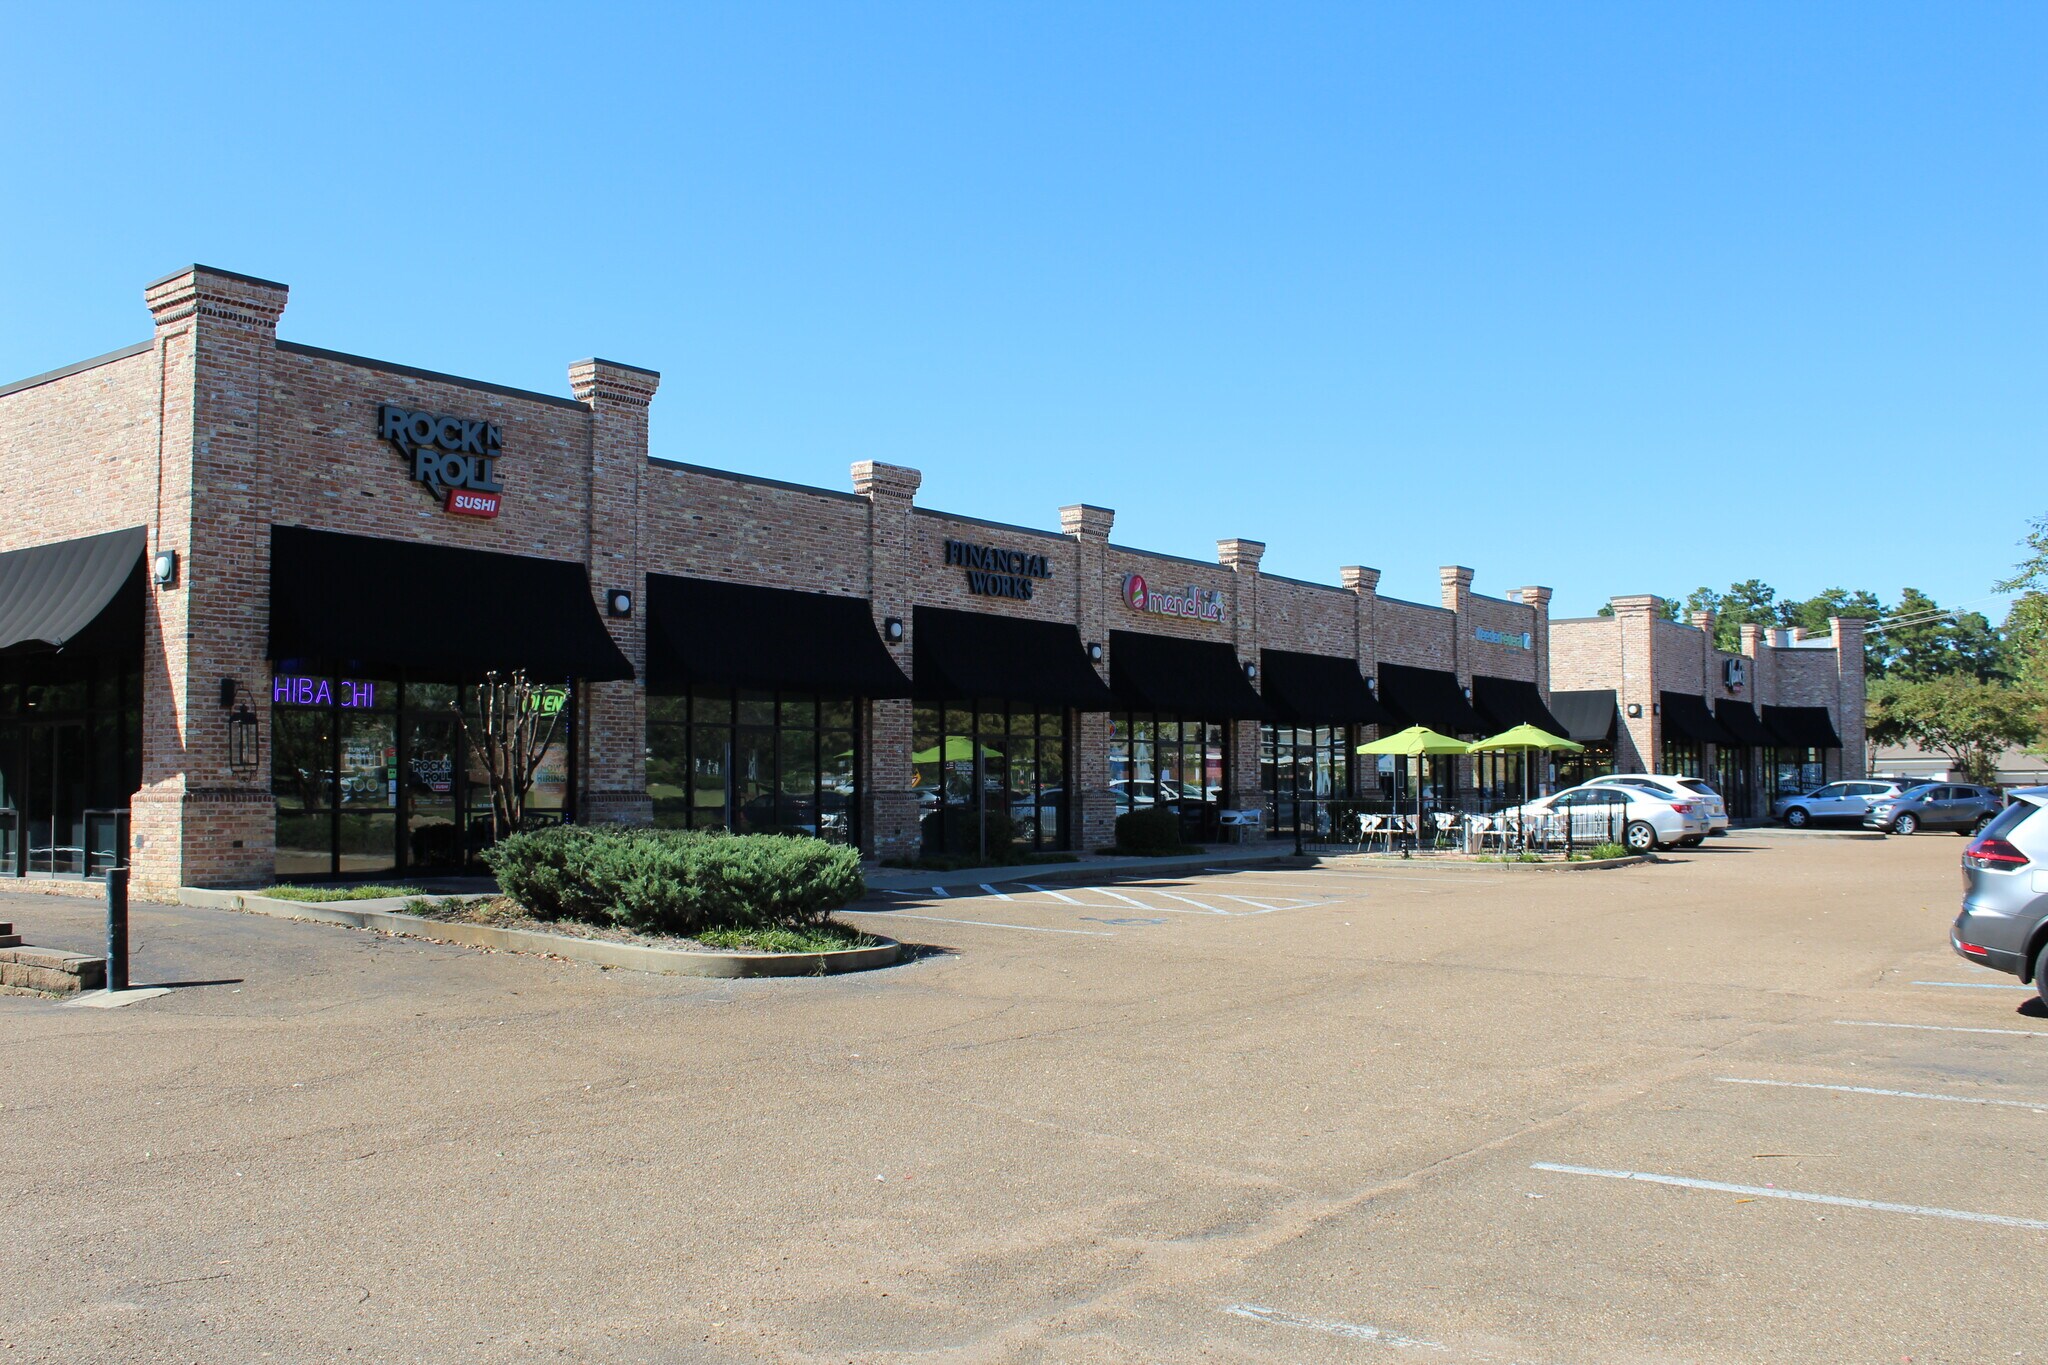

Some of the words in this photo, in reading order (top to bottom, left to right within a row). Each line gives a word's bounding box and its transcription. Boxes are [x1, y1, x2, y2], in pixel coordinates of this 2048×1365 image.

[381, 405, 486, 459] ROCK
[414, 448, 503, 500] ROLL
[454, 494, 496, 512] SUSHI
[946, 540, 1053, 579] FINANCIAL
[968, 570, 1033, 600] WORKS
[413, 760, 444, 775] ROCK
[423, 772, 451, 786] ROLL
[536, 774, 567, 783] HIRING
